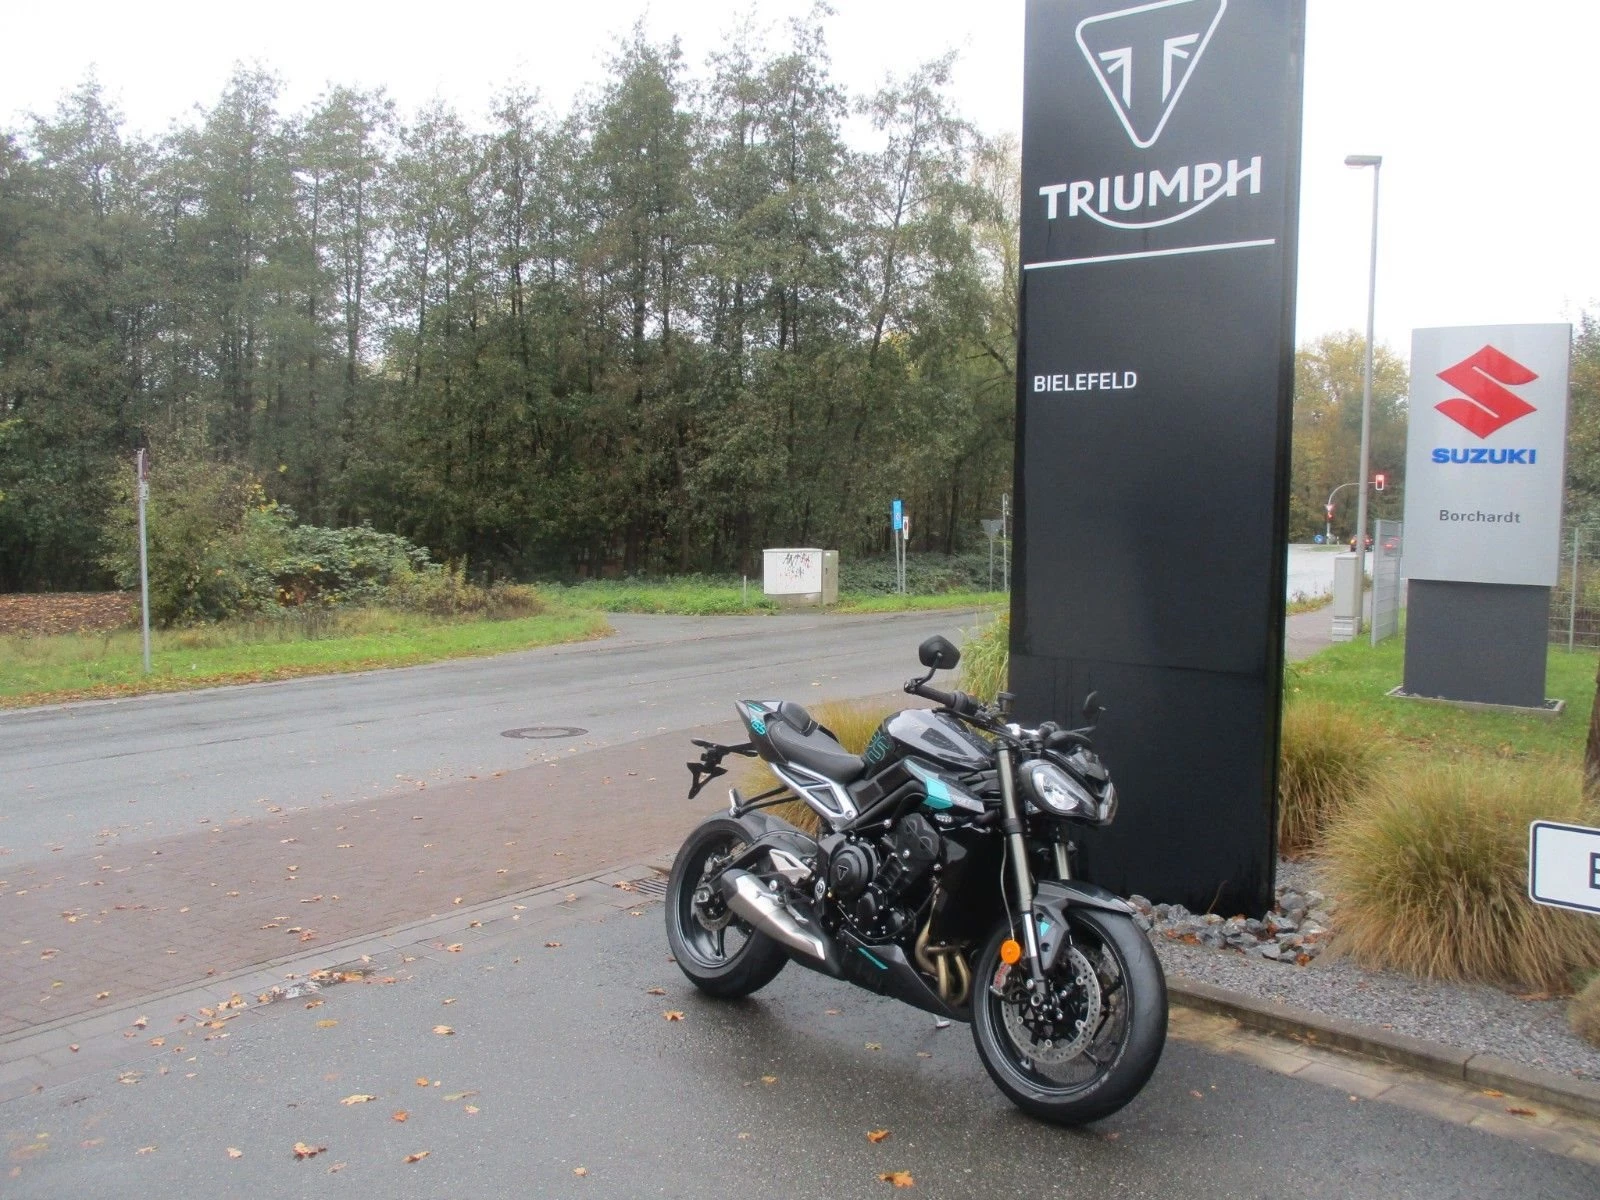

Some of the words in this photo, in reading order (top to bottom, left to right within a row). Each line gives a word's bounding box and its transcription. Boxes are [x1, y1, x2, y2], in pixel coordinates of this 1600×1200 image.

[1039, 156, 1261, 229] TRIUMPH
[1033, 371, 1137, 392] BIELEFELD
[1431, 447, 1536, 464] SUZUKI
[1439, 509, 1521, 523] Borchardt
